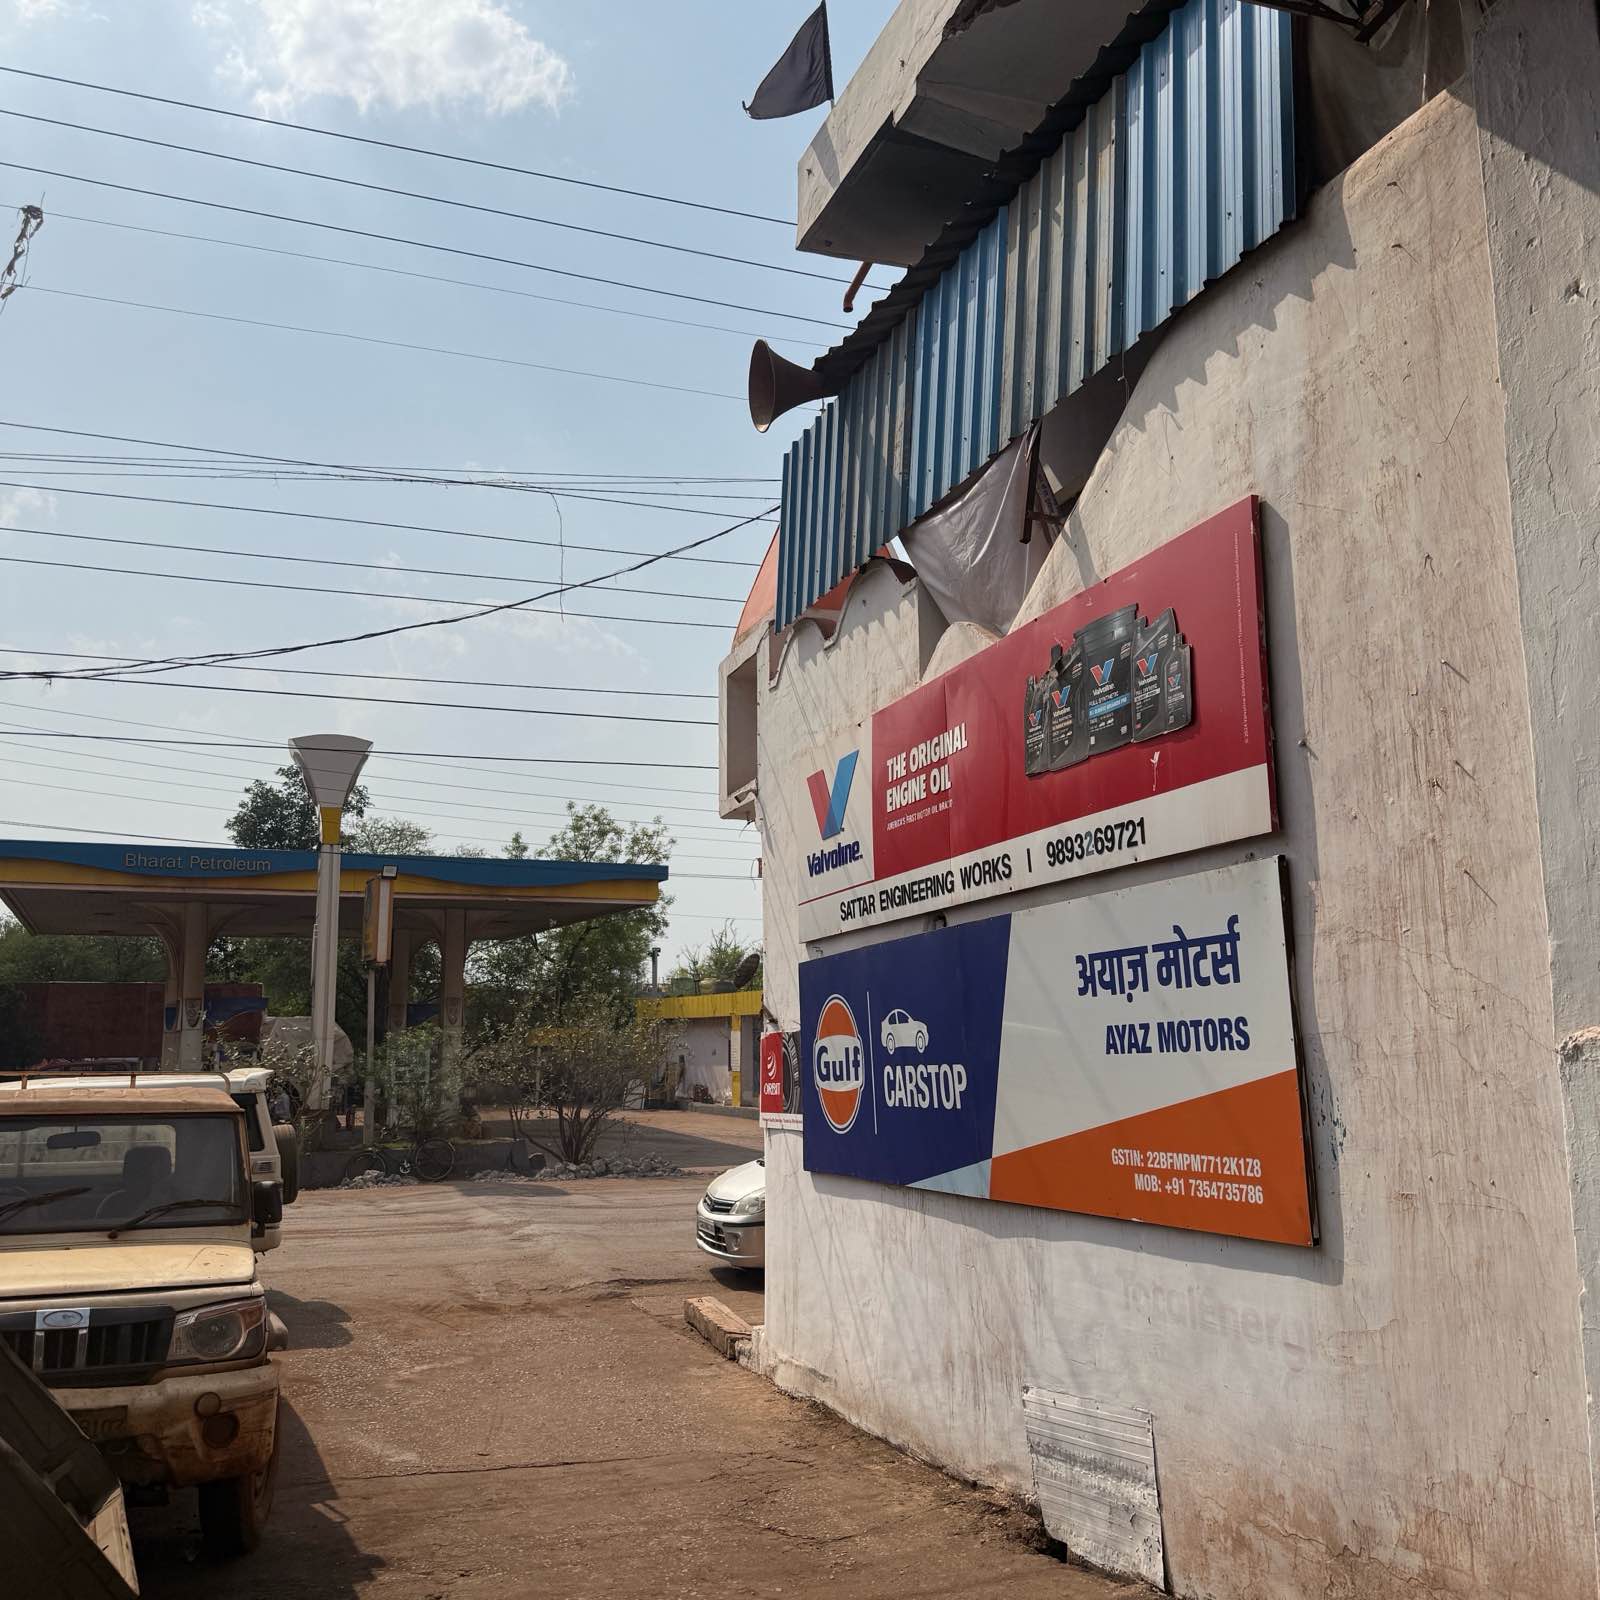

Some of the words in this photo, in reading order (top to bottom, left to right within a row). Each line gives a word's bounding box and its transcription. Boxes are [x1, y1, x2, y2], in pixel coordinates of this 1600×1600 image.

[886, 752, 907, 783] THE
[909, 722, 968, 773] ORIGINAL
[886, 773, 927, 813] ENGINE
[930, 764, 952, 794] OIL
[125, 853, 184, 868] Bharat
[189, 855, 272, 871] Petroleum
[840, 894, 876, 921] SATTAR
[879, 870, 955, 911] ENGINEERING
[960, 853, 1013, 890] WORKS
[1046, 816, 1146, 867] 9893269721
[1075, 945, 1149, 1003] अयाज़
[1152, 914, 1241, 989] मोटर्स
[1105, 1022, 1152, 1055] AYAZ
[1157, 1016, 1250, 1053] MOTORS
[816, 1045, 861, 1082] Gulf
[763, 1082, 781, 1096] ORBIT
[883, 1063, 967, 1109] CARSTOP
[1111, 1148, 1144, 1167] GSTIN:
[1134, 1173, 1162, 1193] MOB:
[1165, 1177, 1185, 1196] +91
[1188, 1179, 1264, 1204] 7354735786
